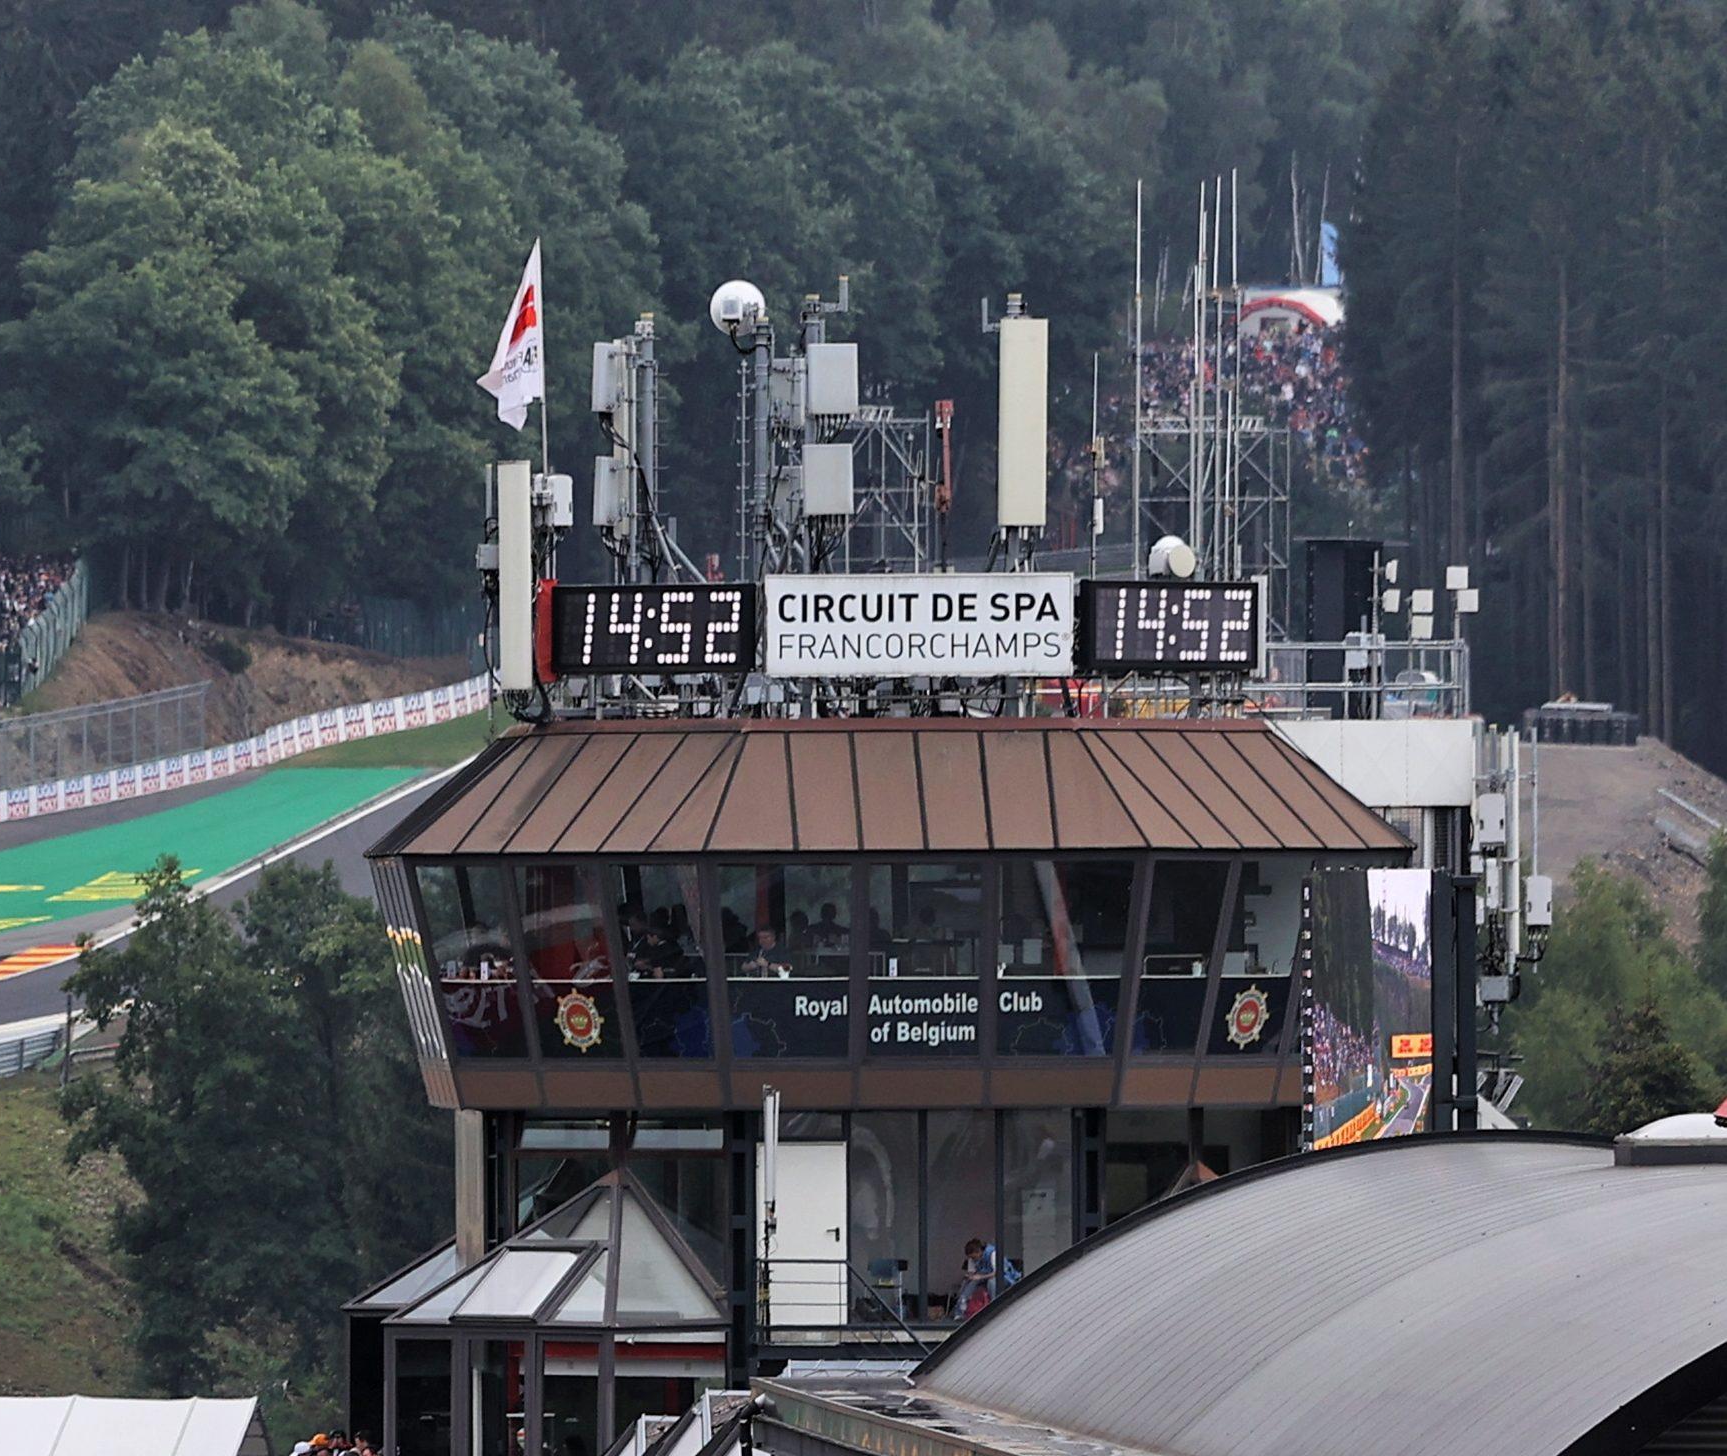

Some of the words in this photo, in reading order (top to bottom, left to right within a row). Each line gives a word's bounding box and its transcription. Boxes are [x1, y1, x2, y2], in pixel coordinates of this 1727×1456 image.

[778, 593, 919, 622] CIRCUIT
[932, 593, 978, 622] DE
[990, 592, 1060, 621] SPA
[582, 592, 742, 665] 14:52
[1115, 588, 1252, 661] 14:52
[779, 632, 1062, 659] FRANCORCHAMPS
[795, 995, 848, 1021] Royal
[867, 993, 978, 1015] Automobile
[999, 992, 1043, 1012] Club
[871, 1022, 891, 1042] of
[897, 1022, 975, 1047] Belgium
